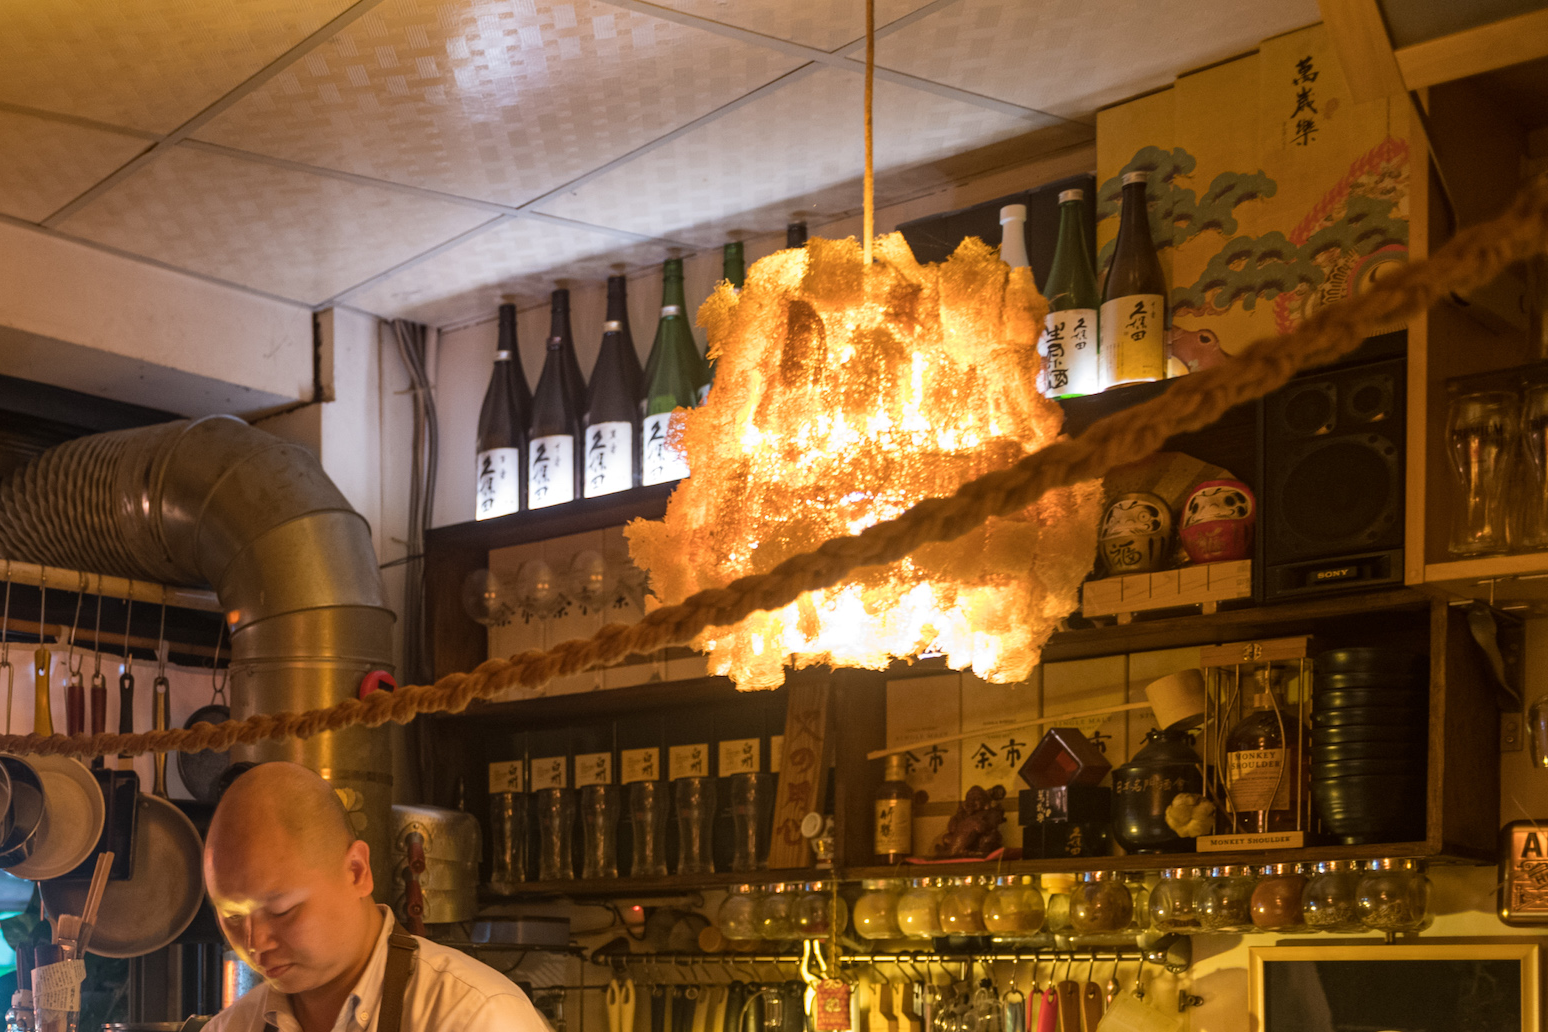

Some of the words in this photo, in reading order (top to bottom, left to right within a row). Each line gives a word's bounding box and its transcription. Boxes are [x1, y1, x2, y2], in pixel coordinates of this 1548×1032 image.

[1071, 317, 1088, 350] 久保田
[1126, 300, 1148, 342] 久保田
[533, 442, 551, 502] 久保田
[588, 429, 607, 490] 久保田
[480, 455, 496, 513] 久保田
[1109, 540, 1143, 566] 福
[1317, 569, 1349, 580] SONY
[971, 738, 1027, 770] 余市
[1231, 761, 1281, 770] SHOULDER
[1234, 751, 1277, 761] MONKEY
[1210, 838, 1245, 846] MONKEY
[1248, 836, 1292, 845] SHOULDER
